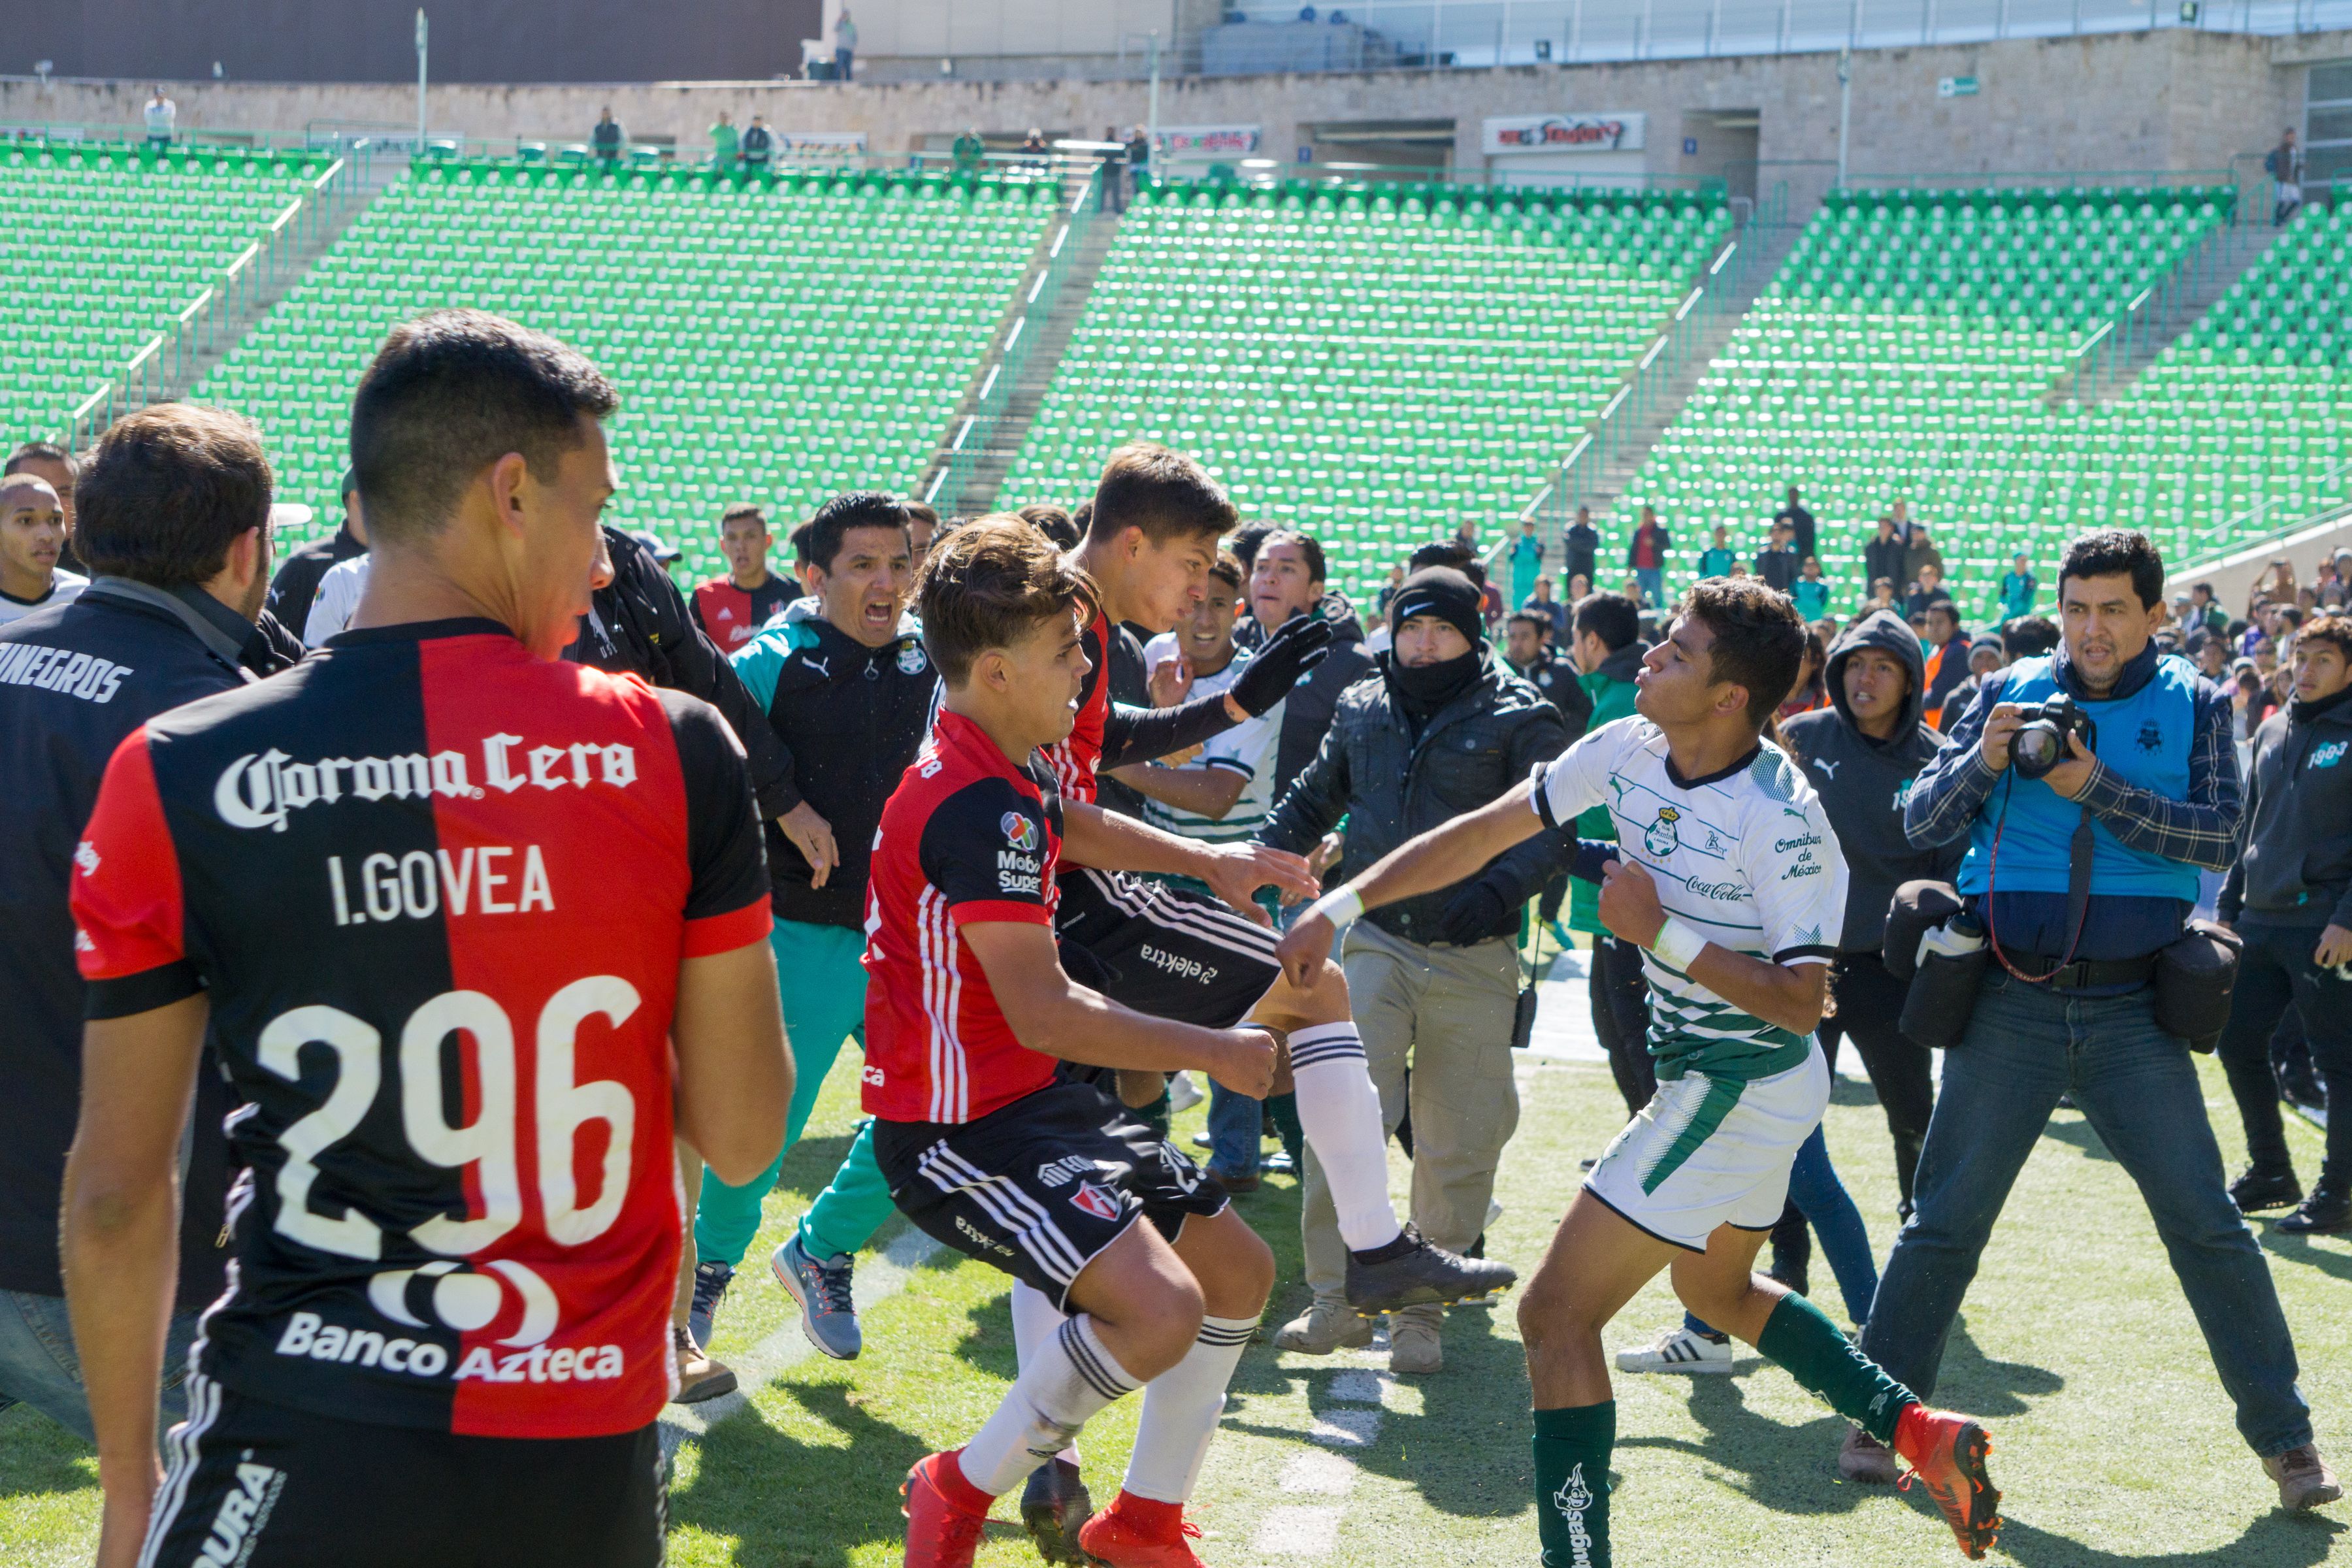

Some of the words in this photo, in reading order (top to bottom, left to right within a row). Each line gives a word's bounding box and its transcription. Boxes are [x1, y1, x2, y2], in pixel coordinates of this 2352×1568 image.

[2308, 740, 2349, 770] 1983
[214, 747, 474, 832] Corona
[1891, 789, 1910, 811] 19
[1774, 831, 1821, 853] Omnibus
[1798, 847, 1812, 862] de
[327, 844, 555, 926] I.GOVEA
[1781, 862, 1821, 880] México
[1686, 875, 1745, 902] Coca-Cola
[1140, 944, 1203, 979] elektra
[257, 975, 642, 1261] 296
[275, 1311, 449, 1377] Banco
[451, 1343, 625, 1383] Azteca
